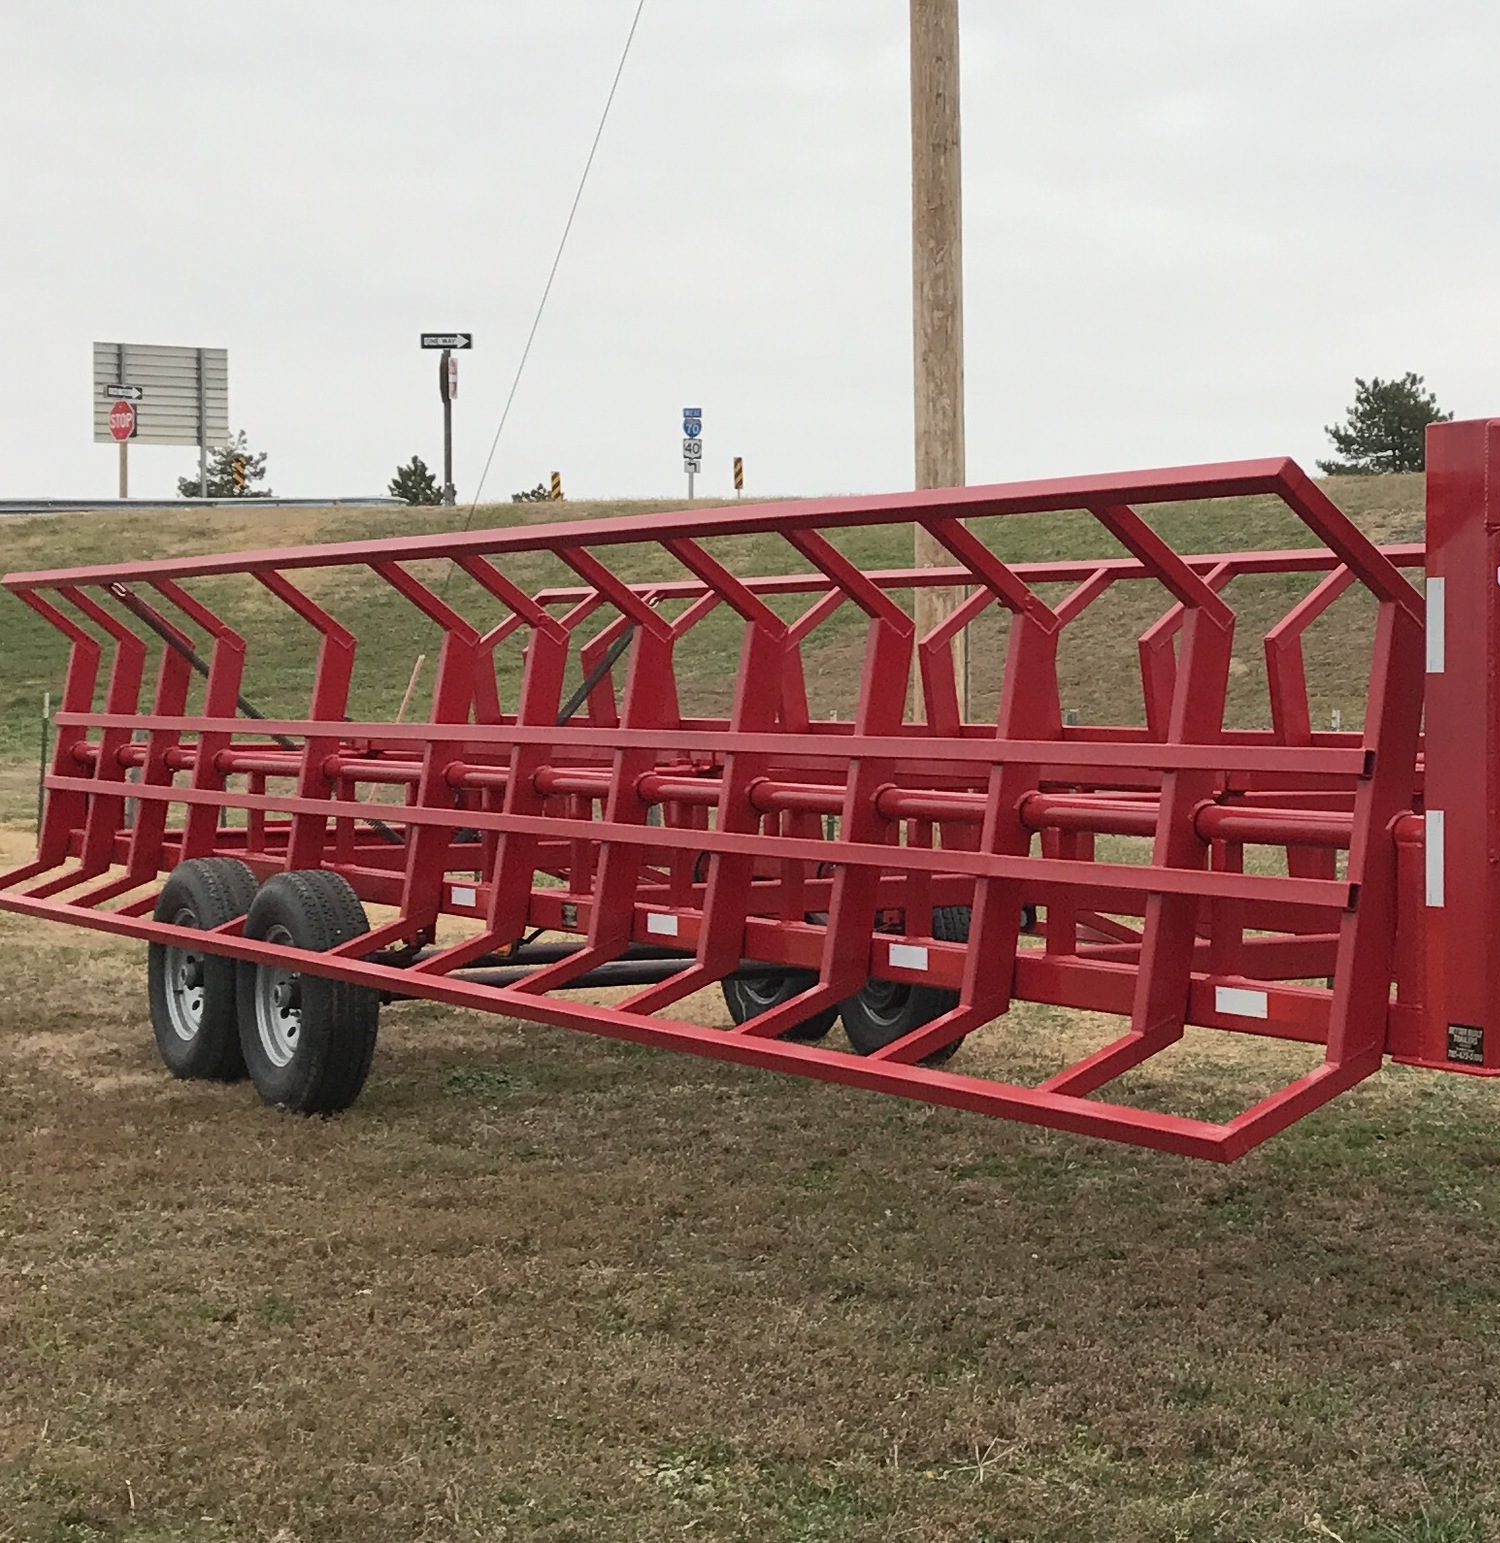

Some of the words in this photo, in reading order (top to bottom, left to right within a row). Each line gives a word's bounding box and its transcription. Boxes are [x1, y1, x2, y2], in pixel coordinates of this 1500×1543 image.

[111, 412, 132, 429] STOP
[685, 423, 700, 435] 70
[684, 443, 700, 455] 40
